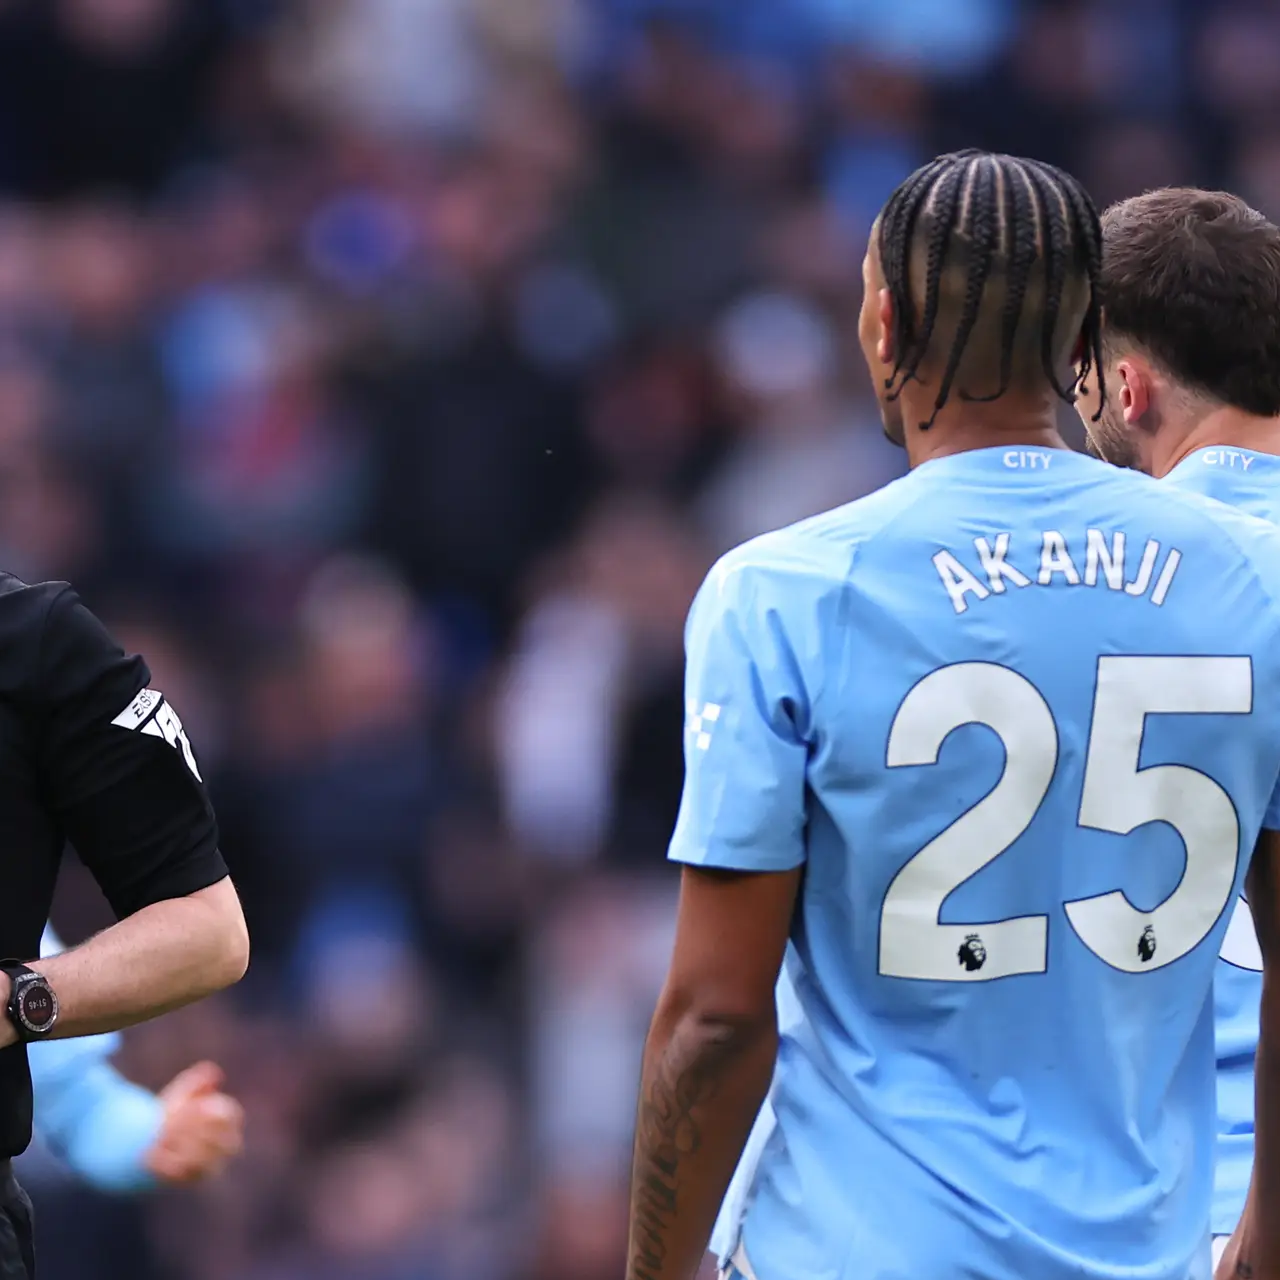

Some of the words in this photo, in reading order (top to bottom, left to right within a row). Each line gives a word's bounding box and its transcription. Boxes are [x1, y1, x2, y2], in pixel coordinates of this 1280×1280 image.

[1003, 450, 1053, 470] CITY
[1201, 450, 1255, 471] CITY
[930, 528, 1183, 615] AKANJI
[877, 653, 1254, 983] 25
